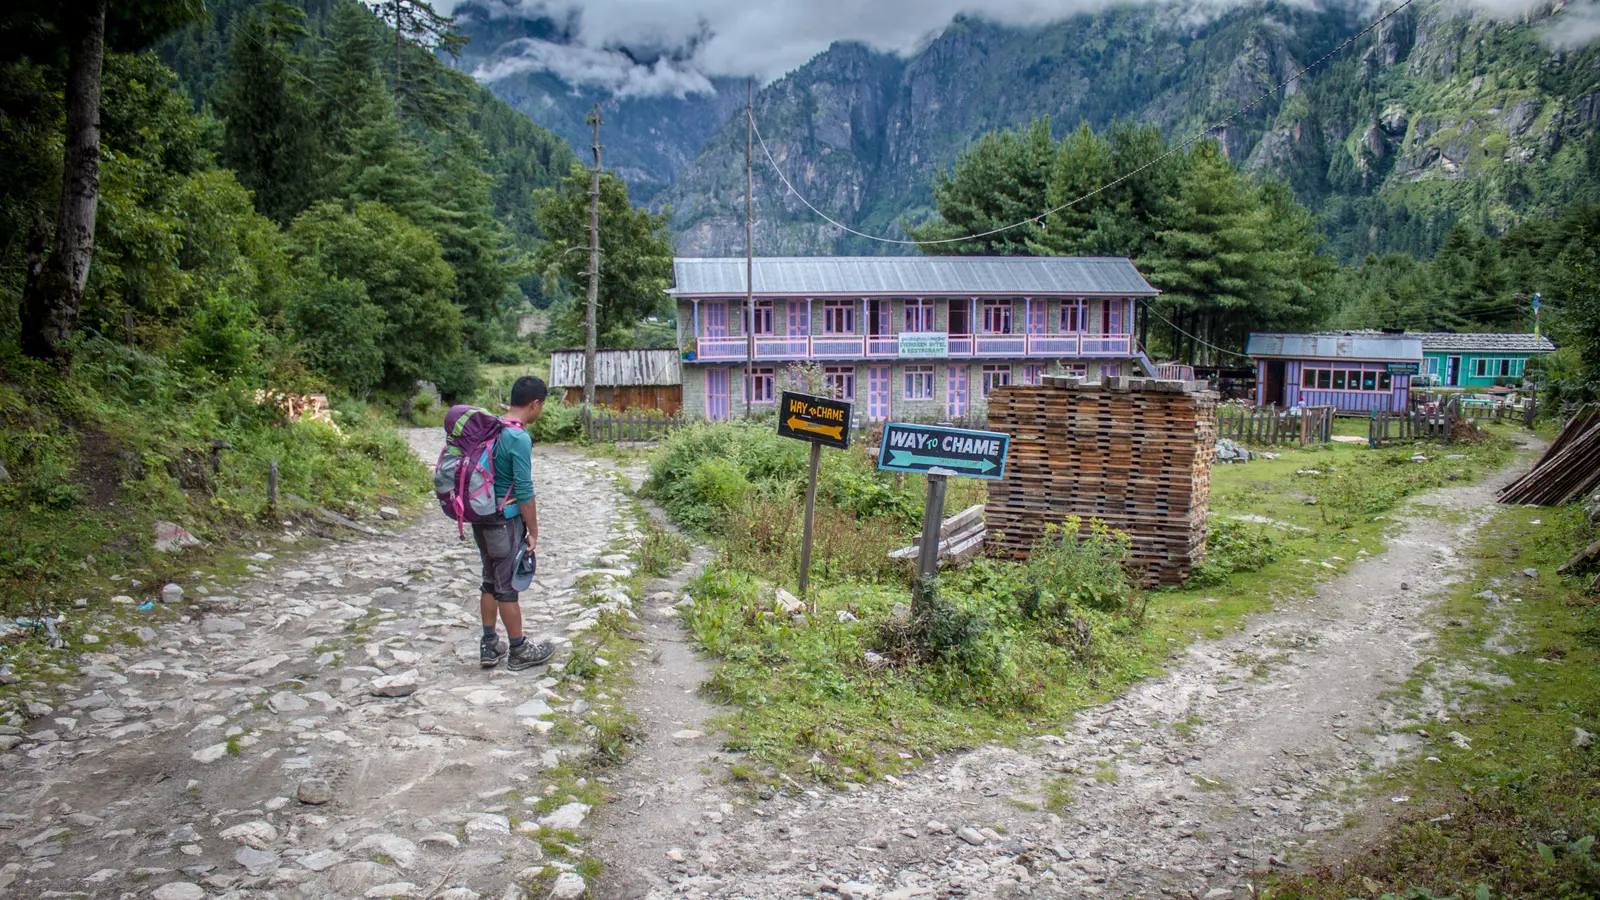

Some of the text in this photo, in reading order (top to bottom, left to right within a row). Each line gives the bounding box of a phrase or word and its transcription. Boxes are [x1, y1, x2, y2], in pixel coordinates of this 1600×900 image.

[790, 400, 808, 414] WAY
[816, 406, 844, 422] CHAME
[890, 430, 1000, 456] WAY TO CHAME
